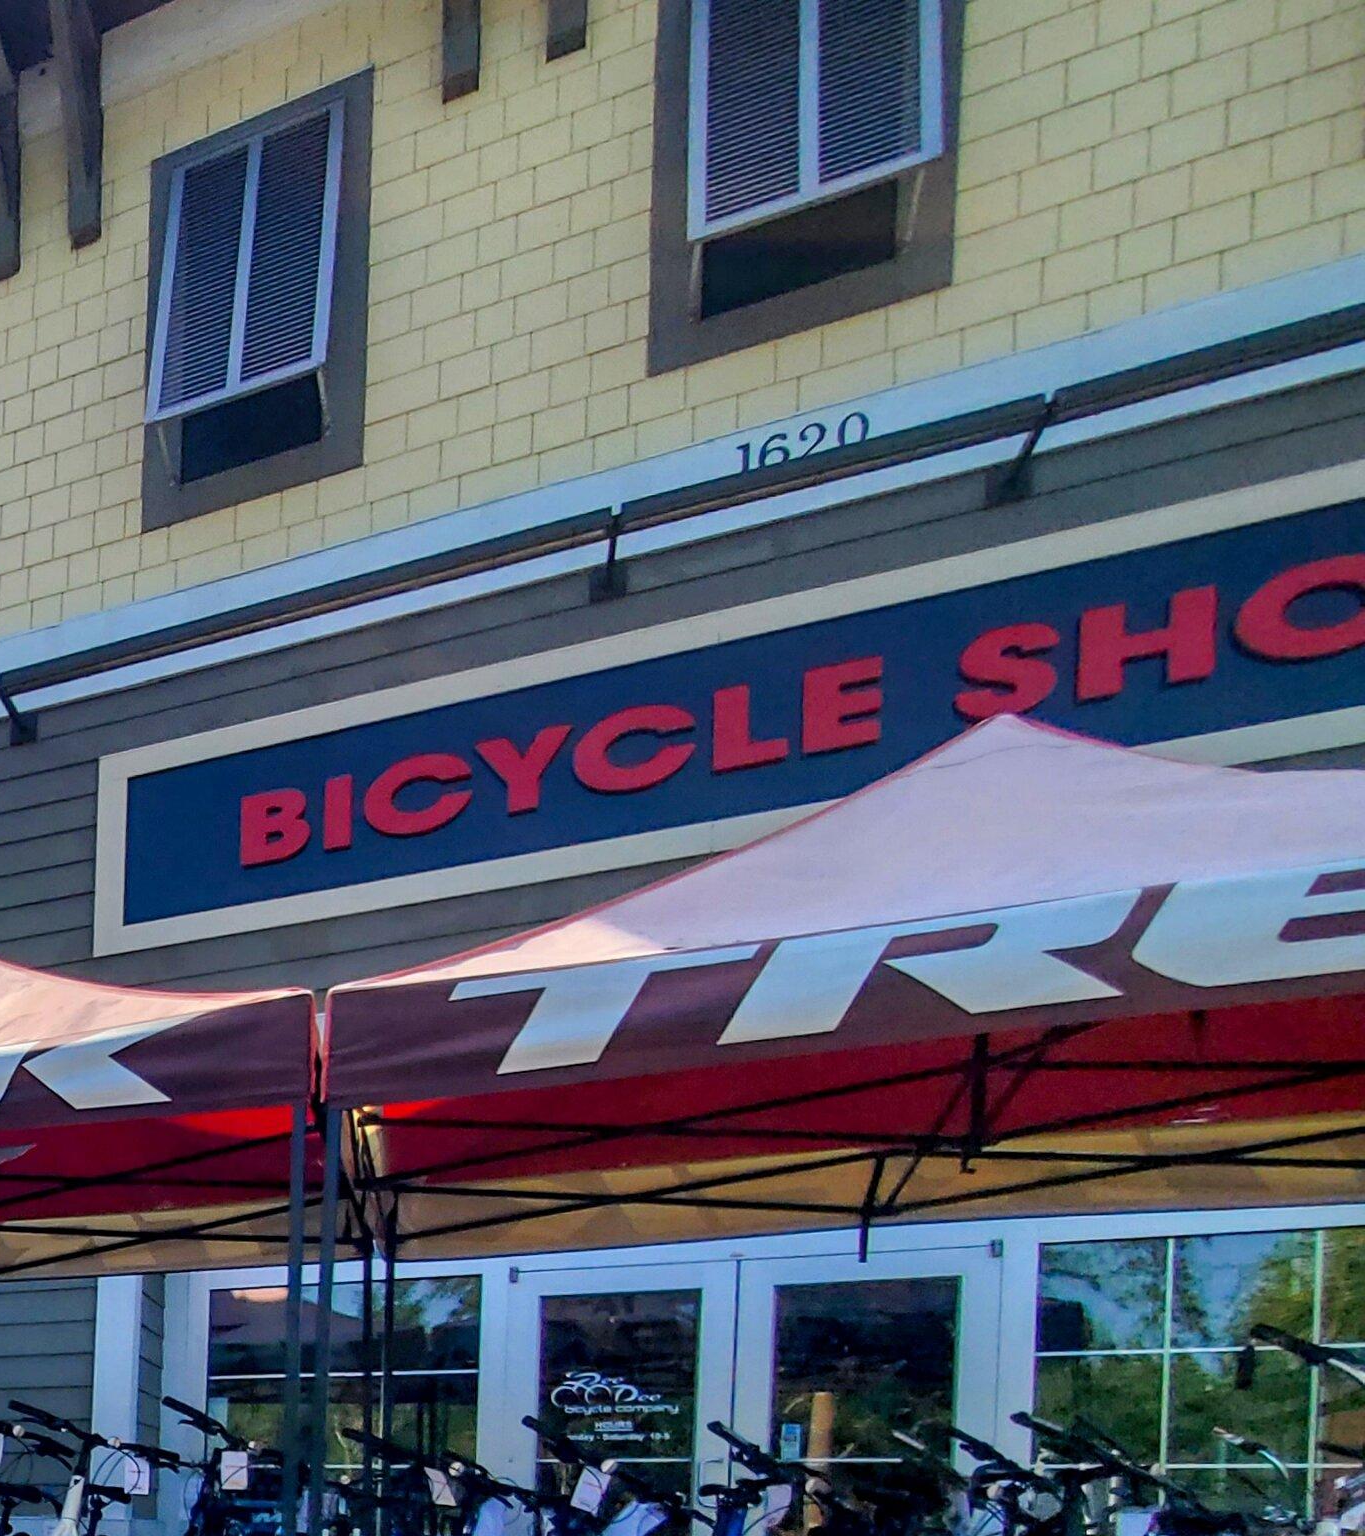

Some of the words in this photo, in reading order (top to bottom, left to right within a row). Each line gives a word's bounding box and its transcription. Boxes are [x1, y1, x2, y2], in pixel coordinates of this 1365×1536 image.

[735, 411, 870, 473] 1620
[237, 655, 885, 870] BICYCLE
[952, 552, 1365, 724] SHO
[564, 1404, 612, 1415] bicycle
[615, 1404, 679, 1415] company
